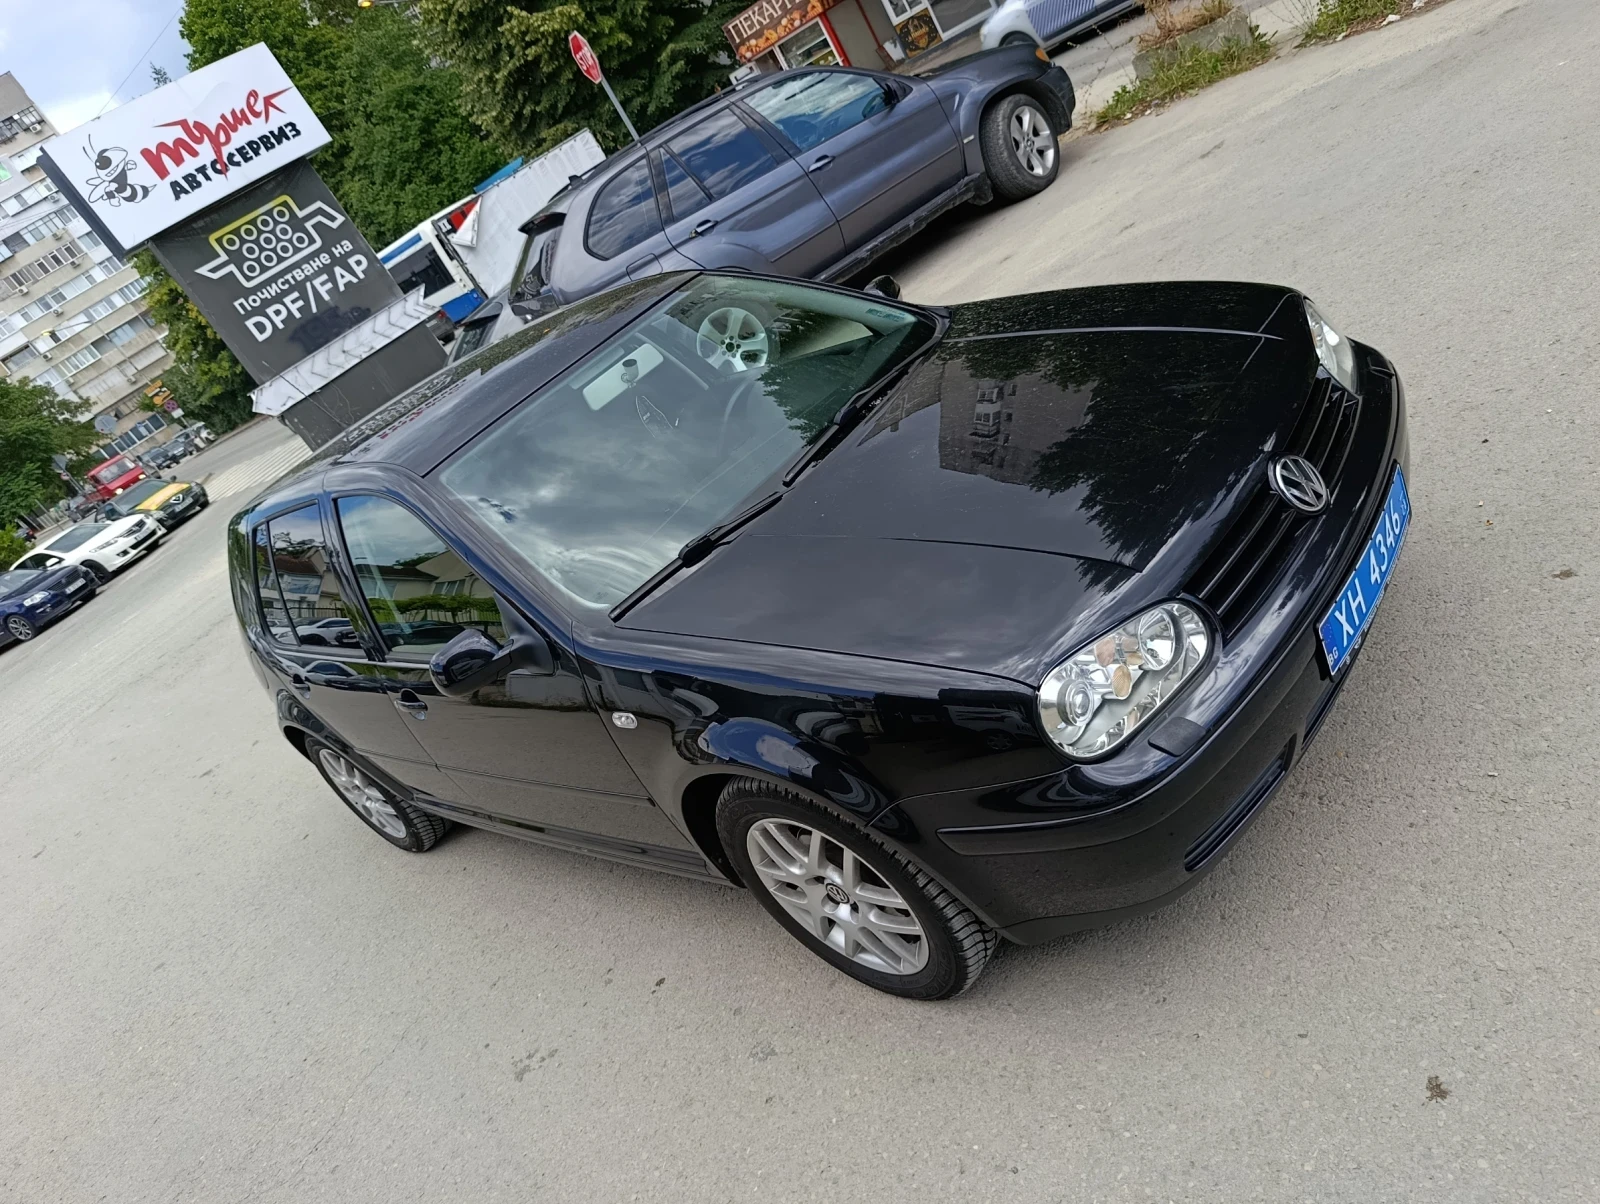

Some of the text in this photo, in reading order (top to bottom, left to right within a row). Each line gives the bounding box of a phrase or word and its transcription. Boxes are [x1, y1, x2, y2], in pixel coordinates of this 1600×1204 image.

[575, 46, 592, 70] STOP
[169, 121, 301, 201] АВТОСЕРВИЗ
[233, 239, 353, 315] Почистване на
[244, 254, 368, 342] DPF/FAP
[1328, 649, 1339, 664] BG
[1334, 577, 1367, 647] XH
[1369, 499, 1400, 585] 4346
